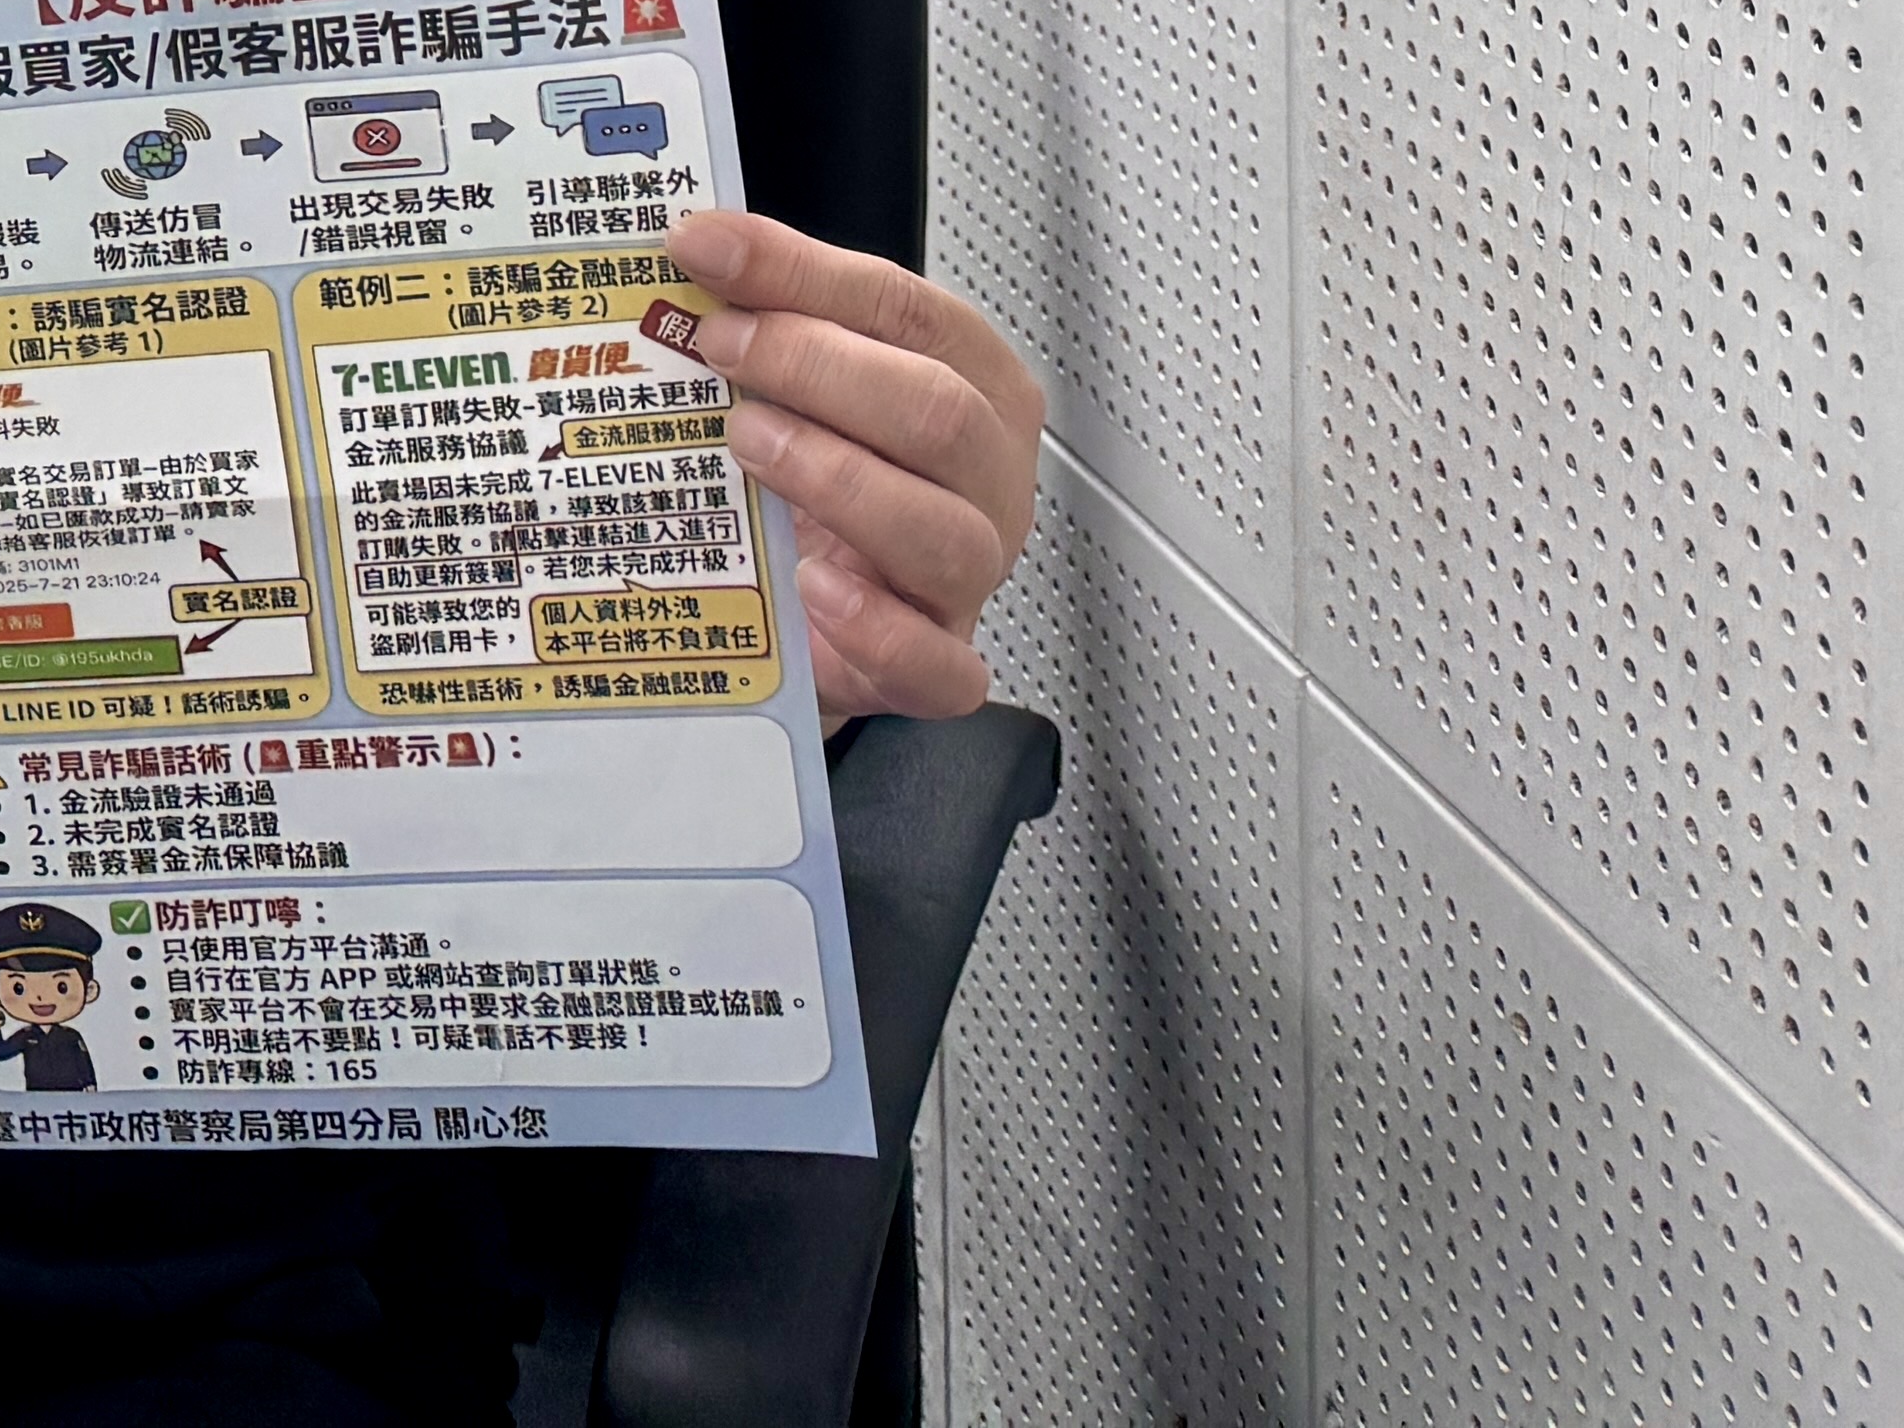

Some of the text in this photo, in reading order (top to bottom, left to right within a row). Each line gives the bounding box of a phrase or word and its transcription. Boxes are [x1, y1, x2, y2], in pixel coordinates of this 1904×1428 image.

[2, 700, 62, 722] LINE
[69, 698, 96, 719] ID
[18, 743, 233, 785] 常見詐騙話術
[319, 967, 378, 988] APP
[434, 1105, 550, 1143] 關心您
